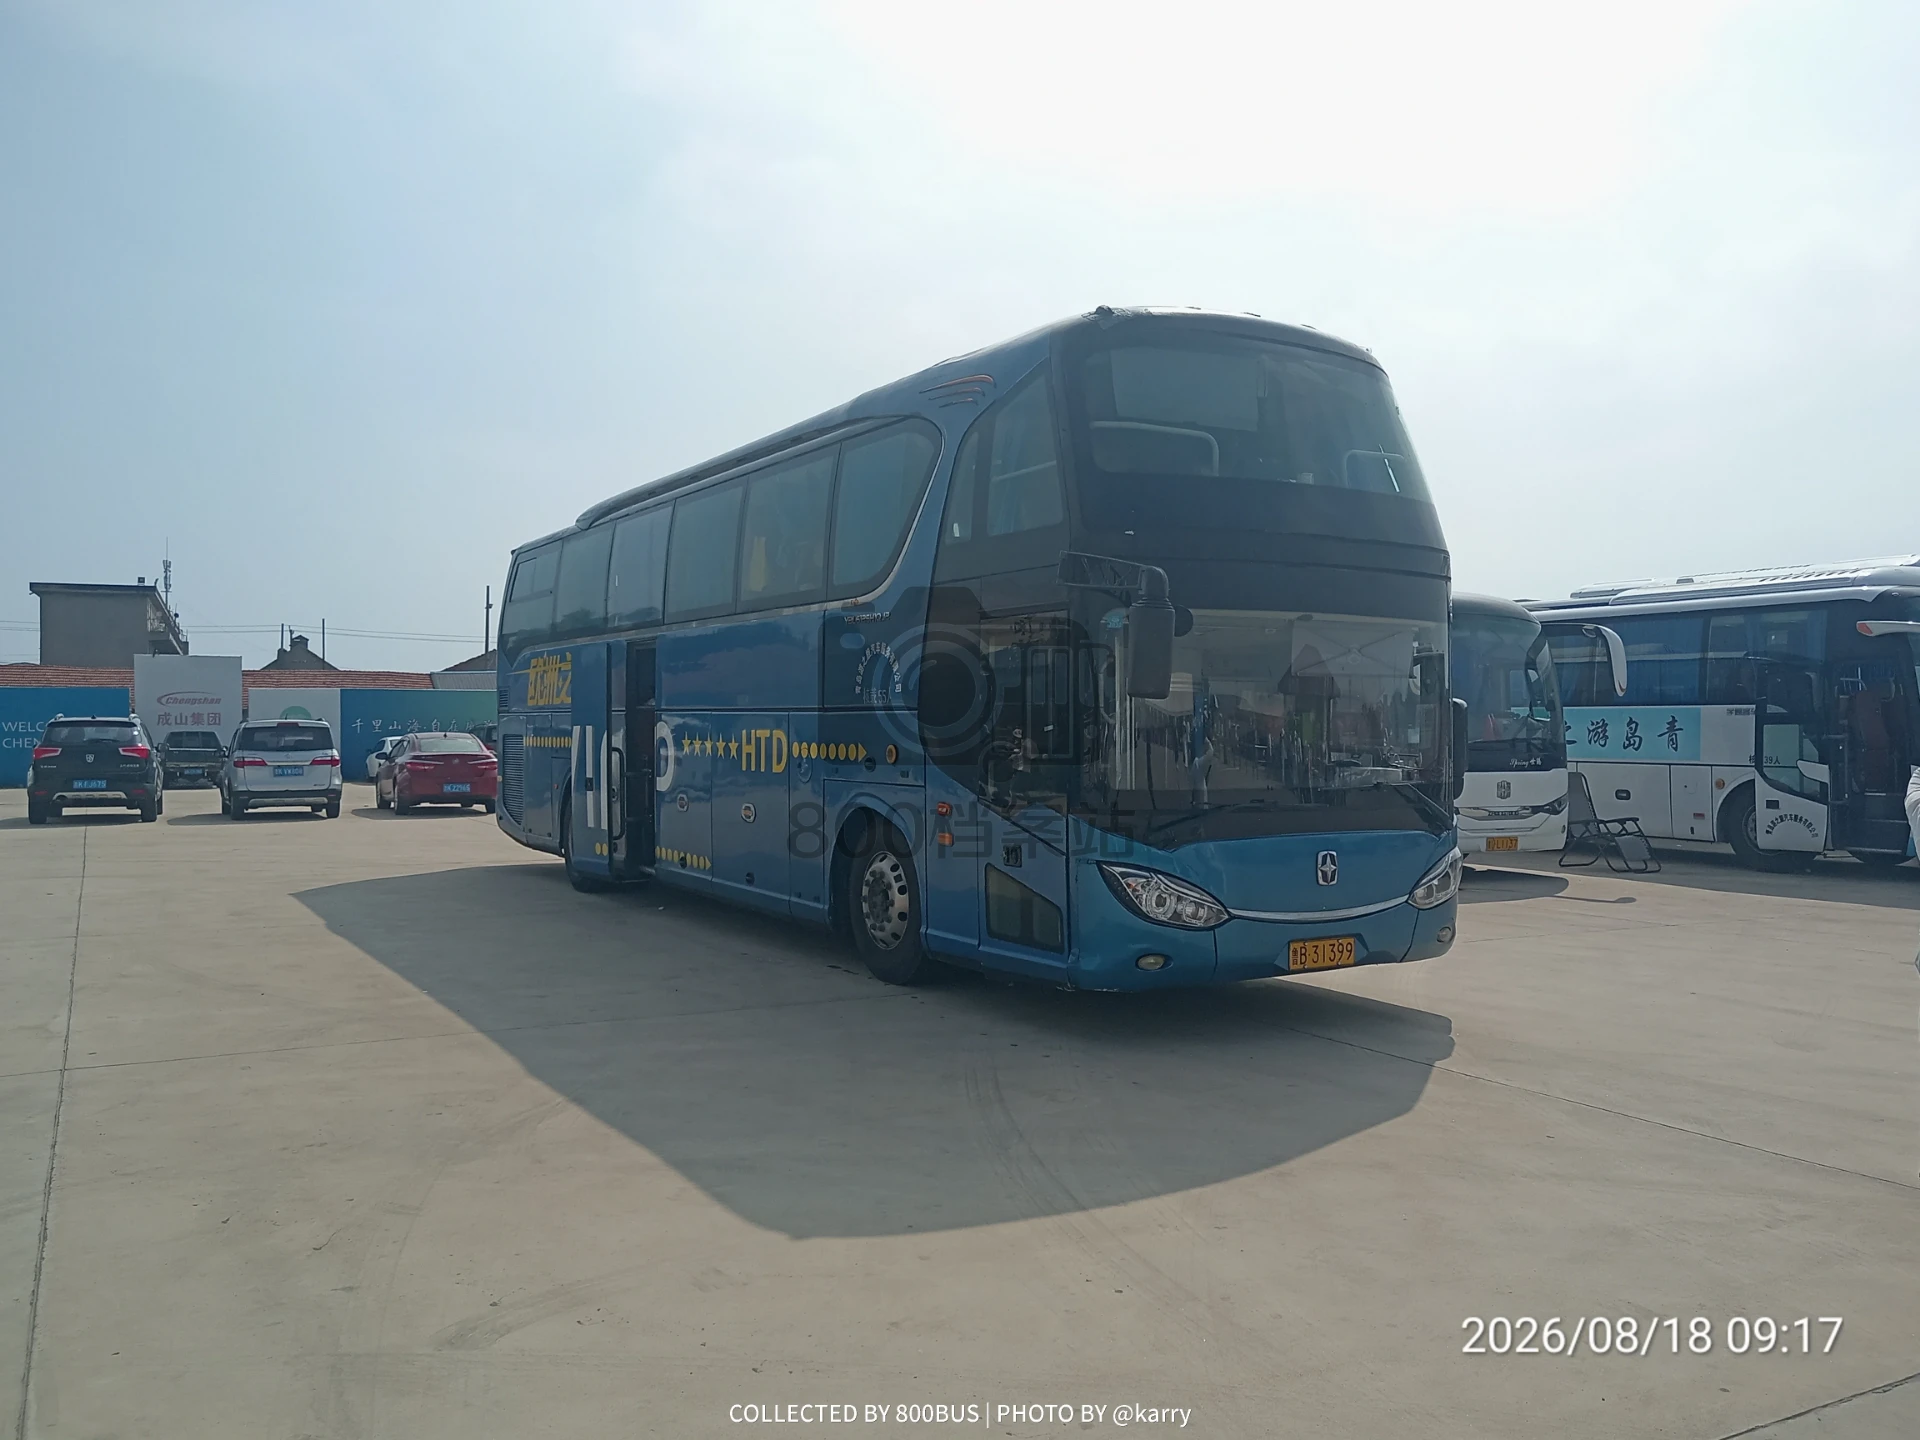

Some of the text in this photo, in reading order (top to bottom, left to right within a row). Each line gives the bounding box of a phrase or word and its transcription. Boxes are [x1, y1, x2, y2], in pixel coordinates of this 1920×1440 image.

[165, 696, 222, 706] Chengshan
[157, 711, 222, 726] 成山集团
[741, 729, 788, 773] HTD
